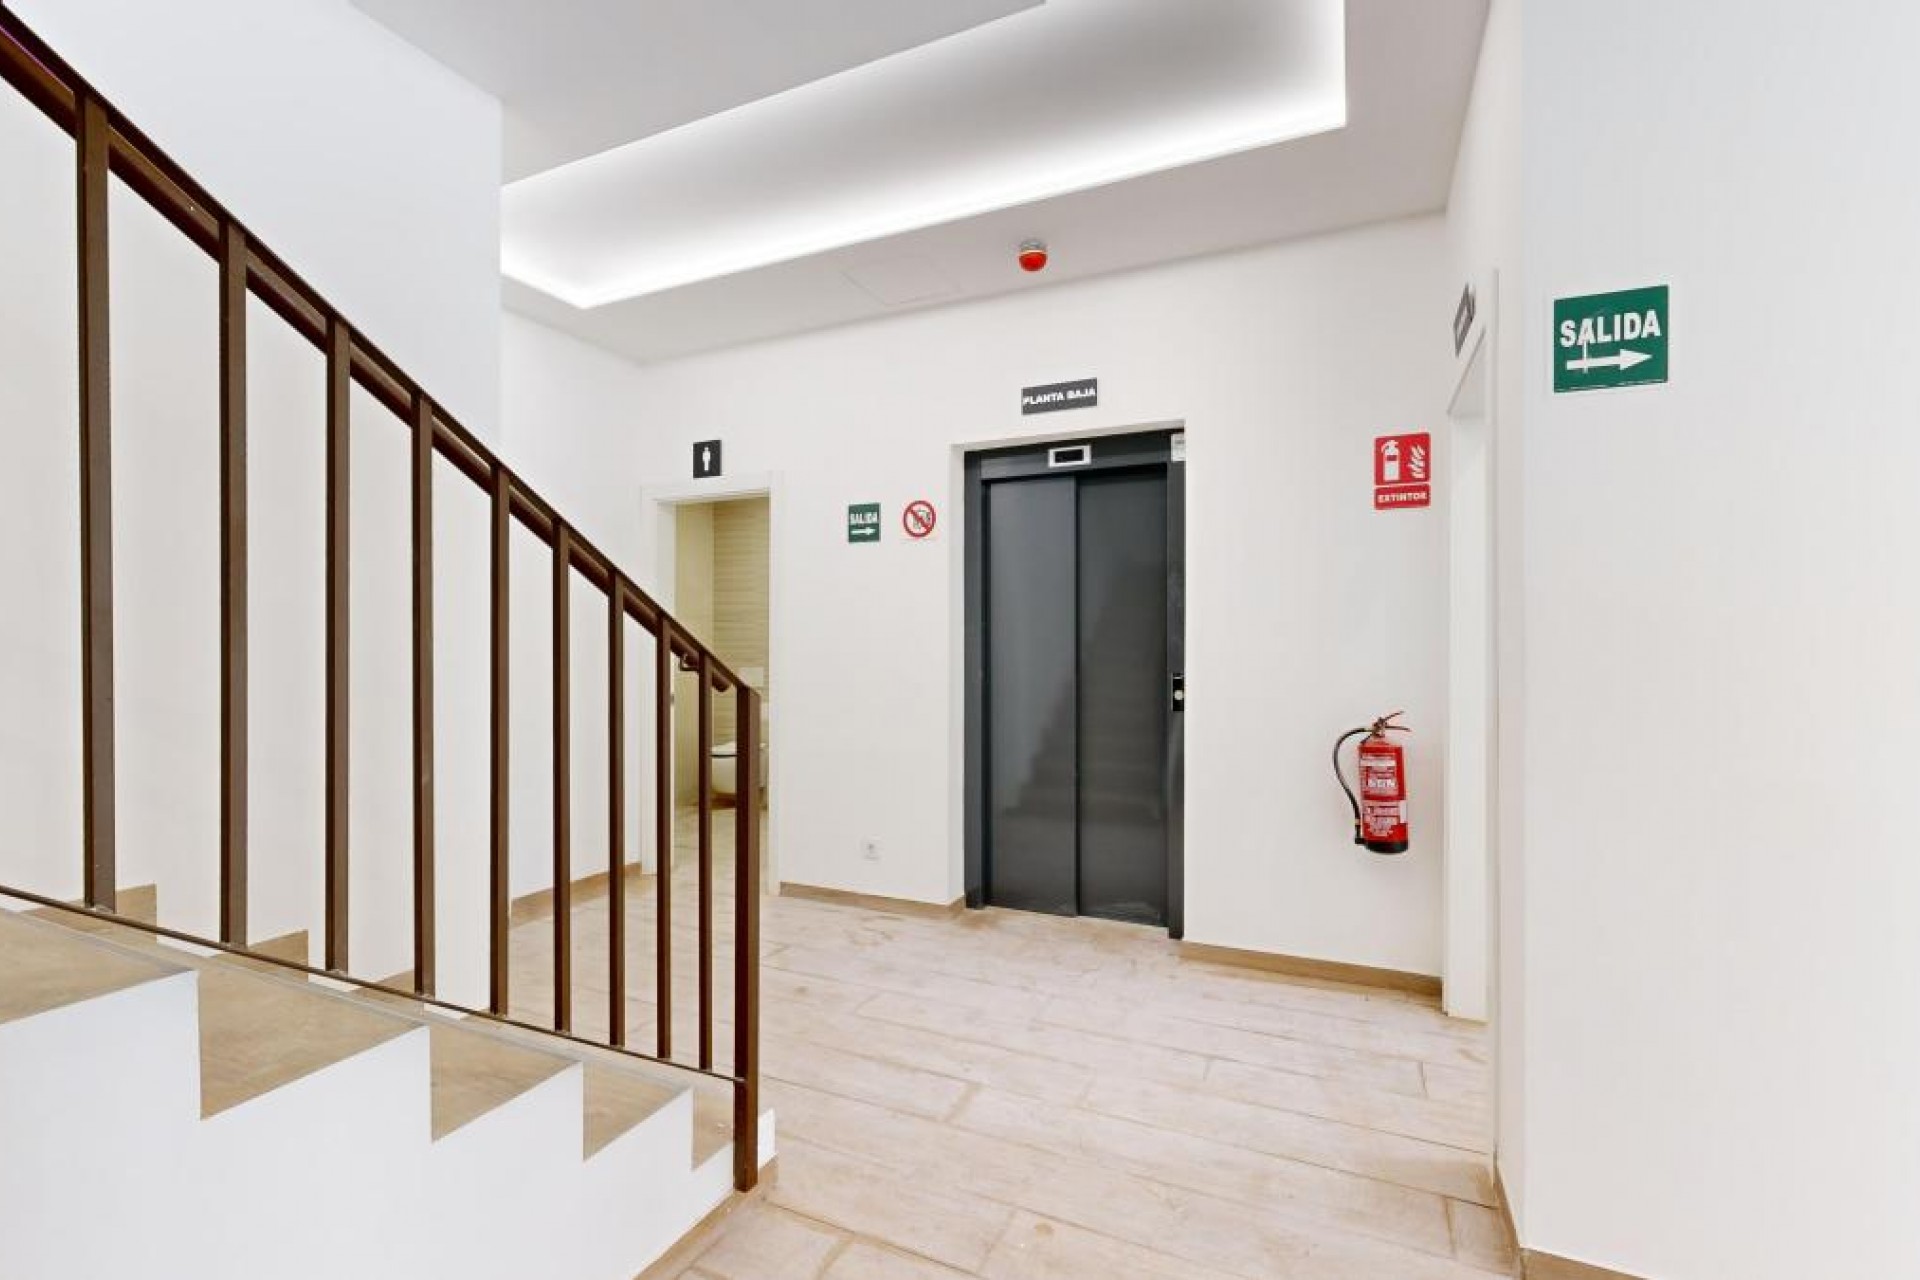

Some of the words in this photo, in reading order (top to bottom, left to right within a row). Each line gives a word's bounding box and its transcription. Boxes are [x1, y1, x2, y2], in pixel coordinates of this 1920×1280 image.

[1560, 308, 1662, 348] SALIDA
[1022, 392, 1065, 406] PLANTA
[1066, 387, 1096, 399] BAJA
[1377, 491, 1428, 503] EXTINTOR
[849, 511, 879, 526] SALIDA
